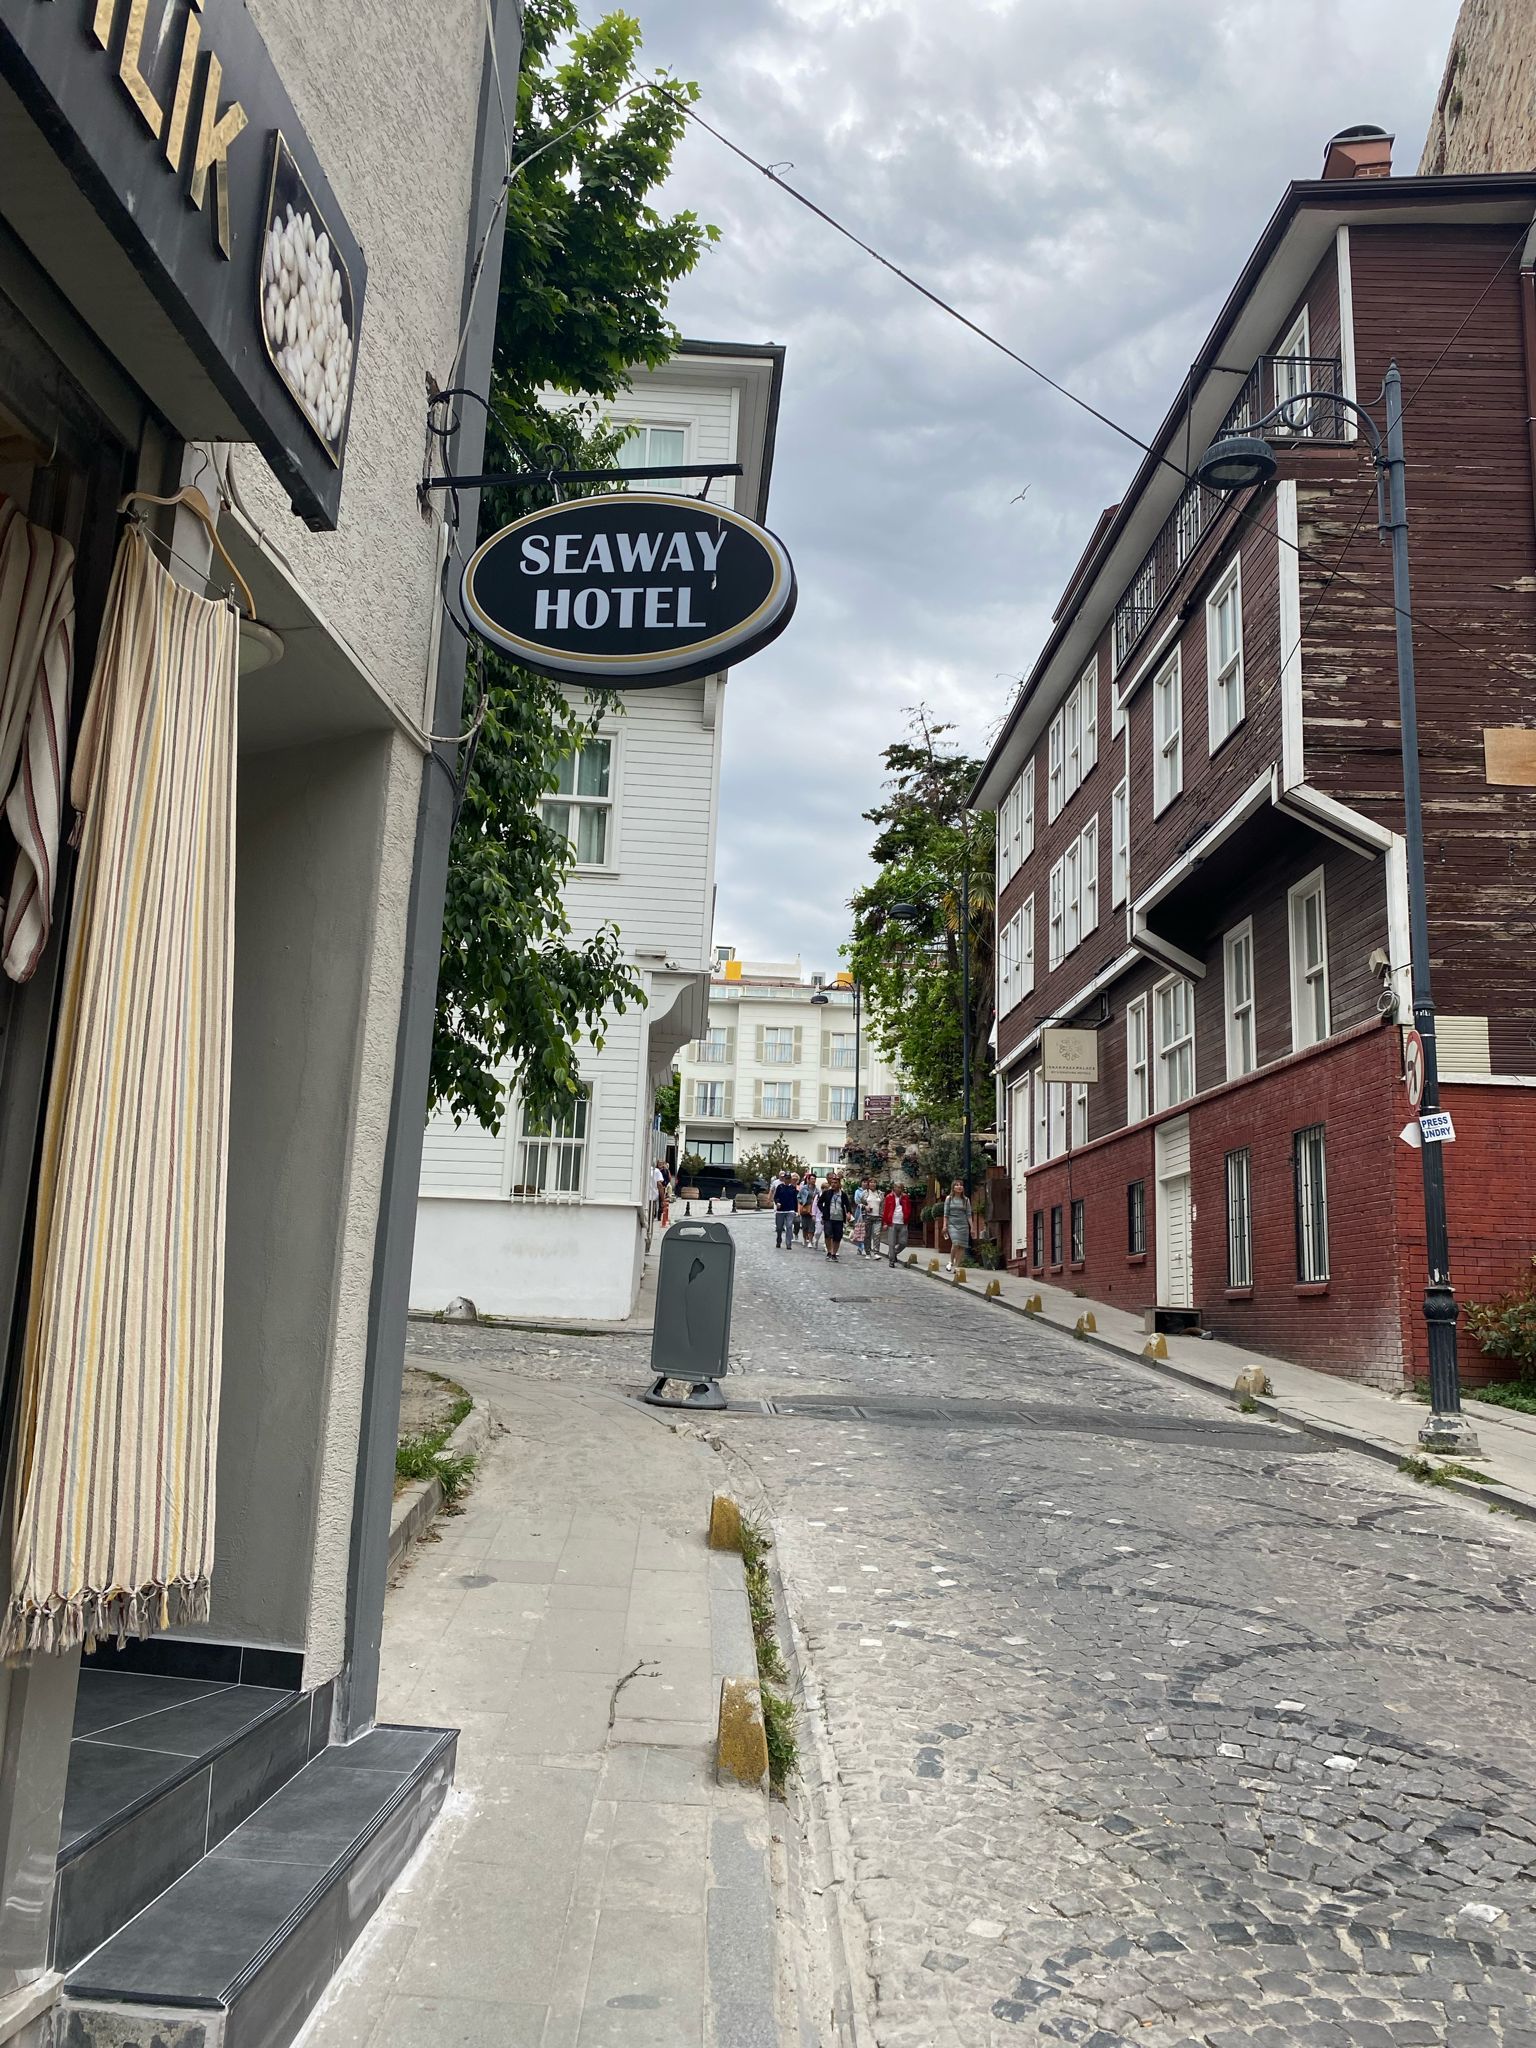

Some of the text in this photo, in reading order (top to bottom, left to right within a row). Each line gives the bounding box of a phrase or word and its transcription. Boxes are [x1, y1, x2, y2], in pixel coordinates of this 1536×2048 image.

[519, 530, 728, 576] SEAWAY
[534, 586, 707, 630] HOTEL
[1421, 1116, 1448, 1128] PRESS
